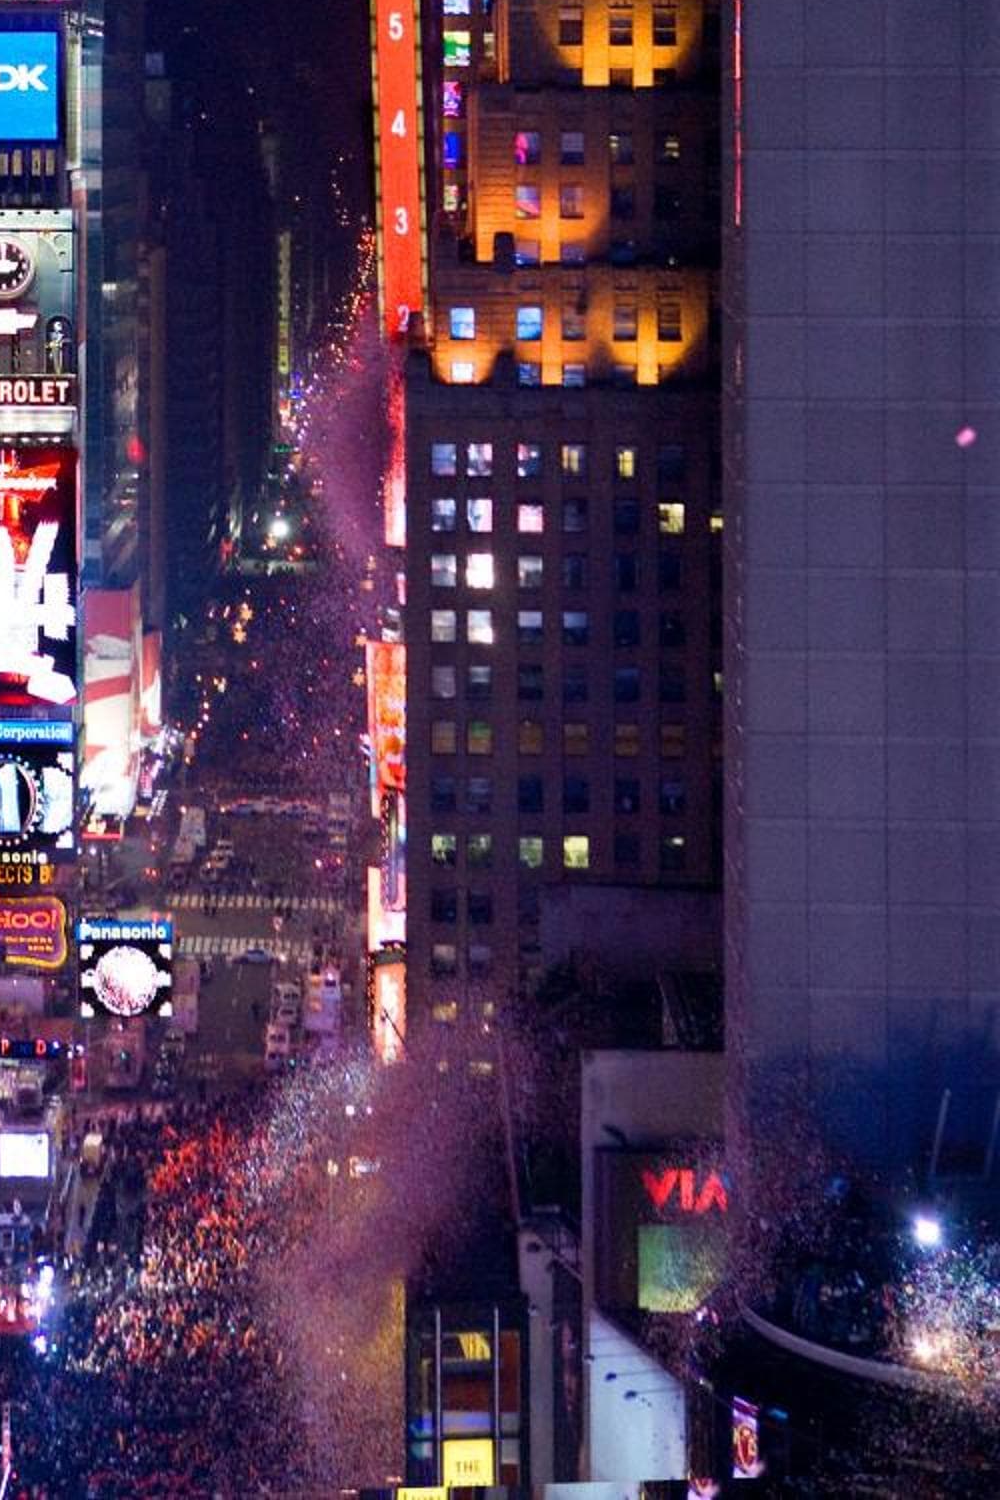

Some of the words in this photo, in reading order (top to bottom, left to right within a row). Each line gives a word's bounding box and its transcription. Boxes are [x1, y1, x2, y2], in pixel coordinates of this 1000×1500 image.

[389, 13, 404, 41] 5
[391, 109, 406, 138] 4
[394, 206, 409, 235] 3
[80, 922, 167, 940] Panasonic
[642, 1167, 728, 1214] VIA
